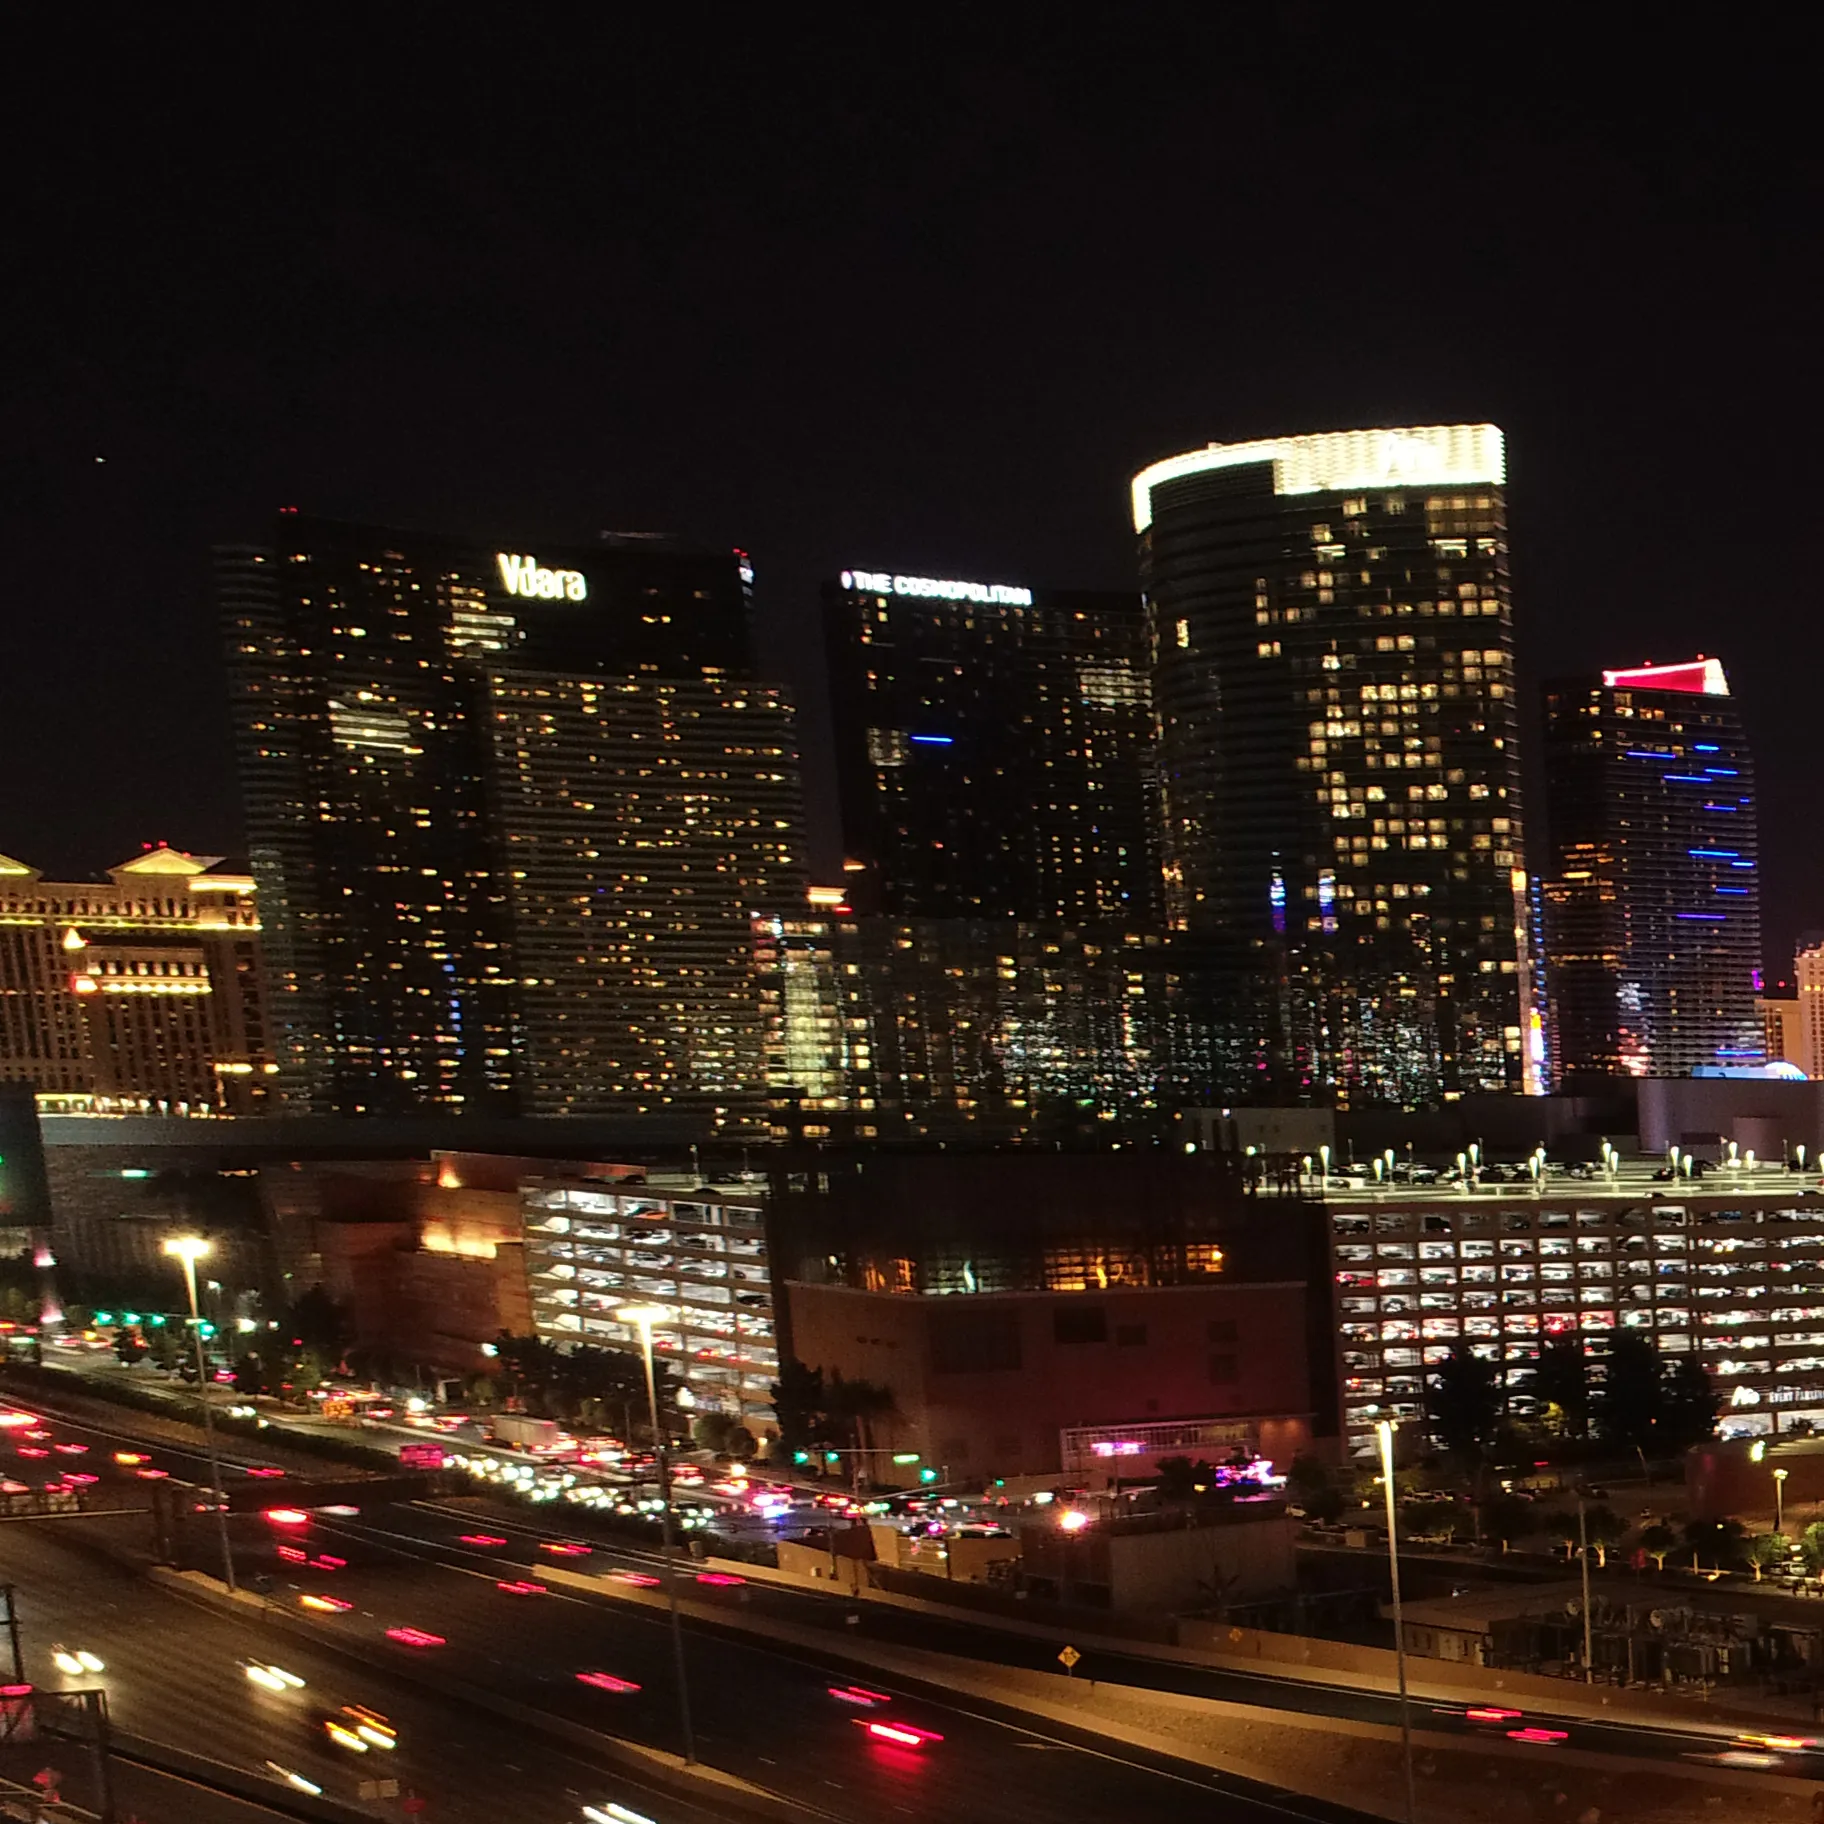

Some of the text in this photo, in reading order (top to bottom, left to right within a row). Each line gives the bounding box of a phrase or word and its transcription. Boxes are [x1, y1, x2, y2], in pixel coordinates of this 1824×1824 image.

[497, 553, 588, 601] Vdara
[852, 571, 1032, 606] THE COSMOPOLITAN
